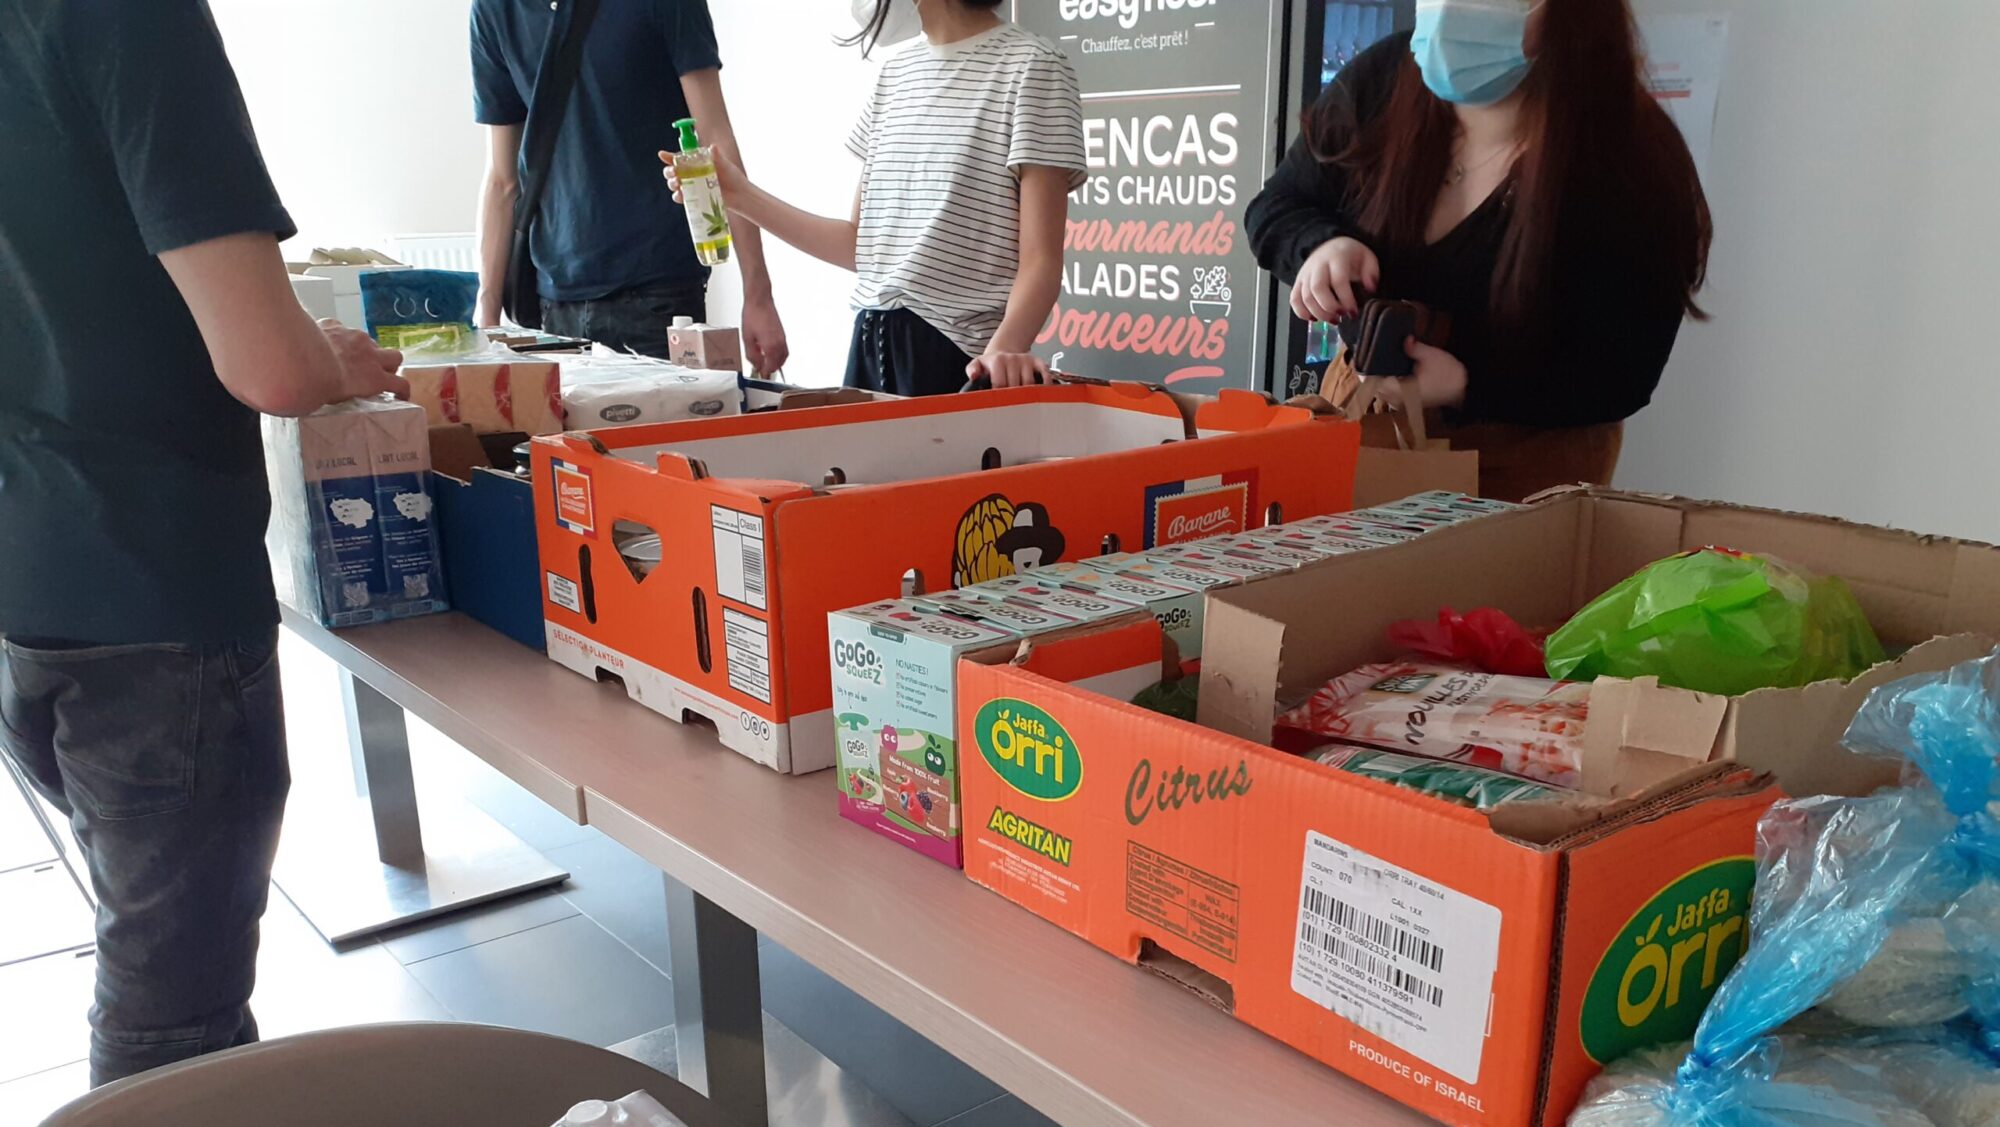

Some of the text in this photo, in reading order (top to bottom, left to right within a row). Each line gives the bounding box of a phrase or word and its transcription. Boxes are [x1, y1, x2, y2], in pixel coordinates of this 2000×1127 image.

[1081, 34, 1132, 53] Chauffez,
[1134, 31, 1158, 49] c'est
[1116, 174, 1237, 206] CHAUDS
[1064, 209, 1236, 257] ourmands
[1060, 261, 1181, 301] ALADES
[1167, 506, 1236, 539] Banane
[834, 638, 875, 668] GoGo
[846, 664, 881, 685] SQUEEZ
[1012, 713, 1046, 738] Jaffa
[1404, 677, 1468, 746] NOUILLES
[991, 717, 1064, 784] Orri
[1125, 758, 1253, 826] Citrus
[988, 806, 1072, 866] AGRITAN
[1338, 871, 1352, 884] 070
[1327, 922, 1342, 935] 729
[1667, 888, 1730, 936] Jaffa
[1323, 953, 1339, 967] 729
[1350, 1039, 1485, 1113] PRODUCE OF ISRAEL
